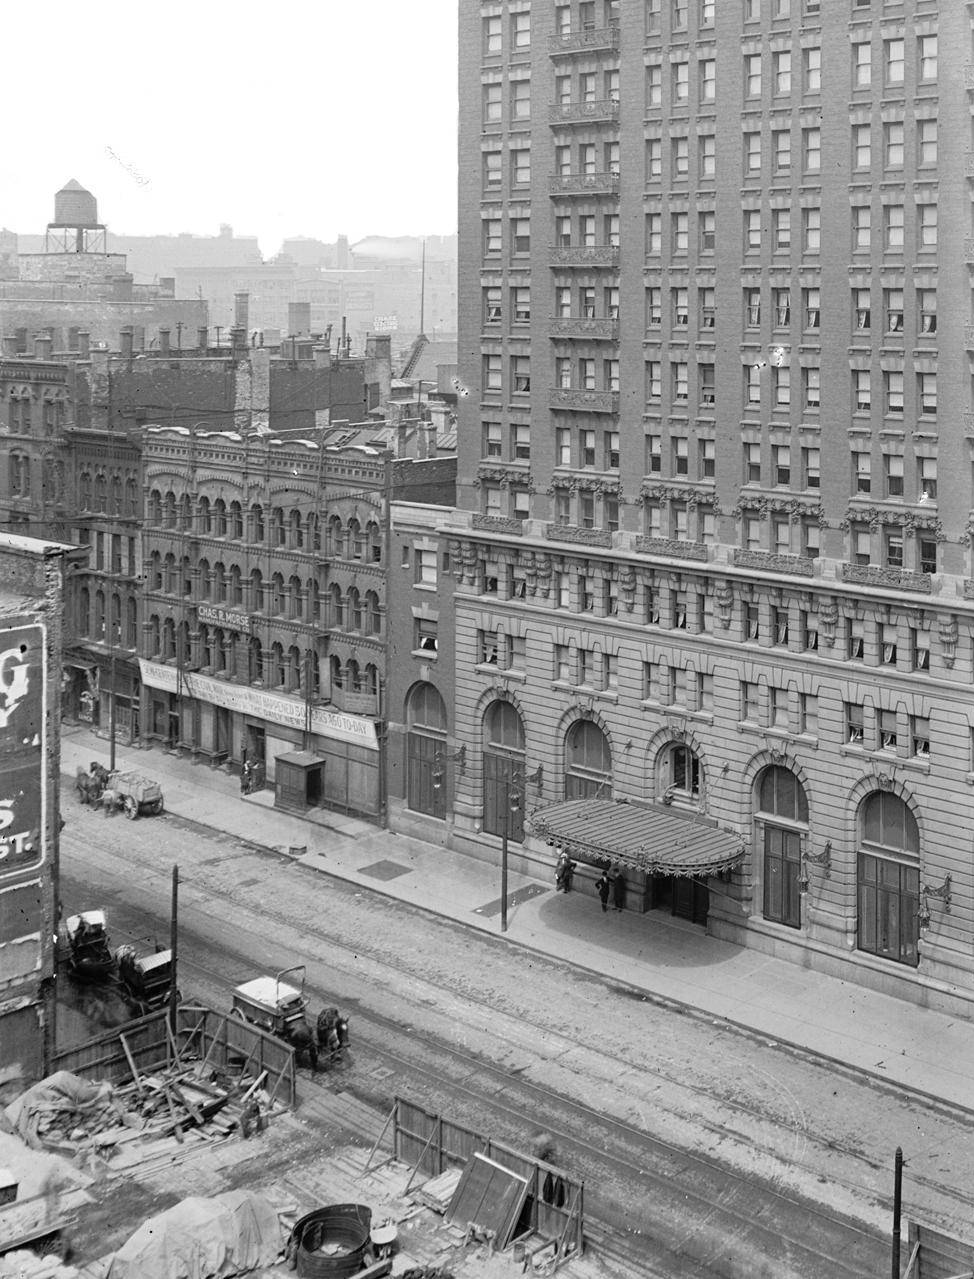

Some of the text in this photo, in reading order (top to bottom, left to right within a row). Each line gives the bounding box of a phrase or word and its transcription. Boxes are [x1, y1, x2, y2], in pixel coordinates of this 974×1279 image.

[198, 606, 218, 619] CHAS.
[225, 612, 250, 627] MORSE
[249, 703, 262, 714] THE
[263, 709, 283, 721] DAILY
[284, 715, 306, 727] NEWS
[263, 696, 294, 715] HAPPENED
[295, 706, 306, 717] 50
[307, 707, 328, 724] EARS
[328, 713, 342, 728] AGO
[342, 717, 367, 734] TO-DAY
